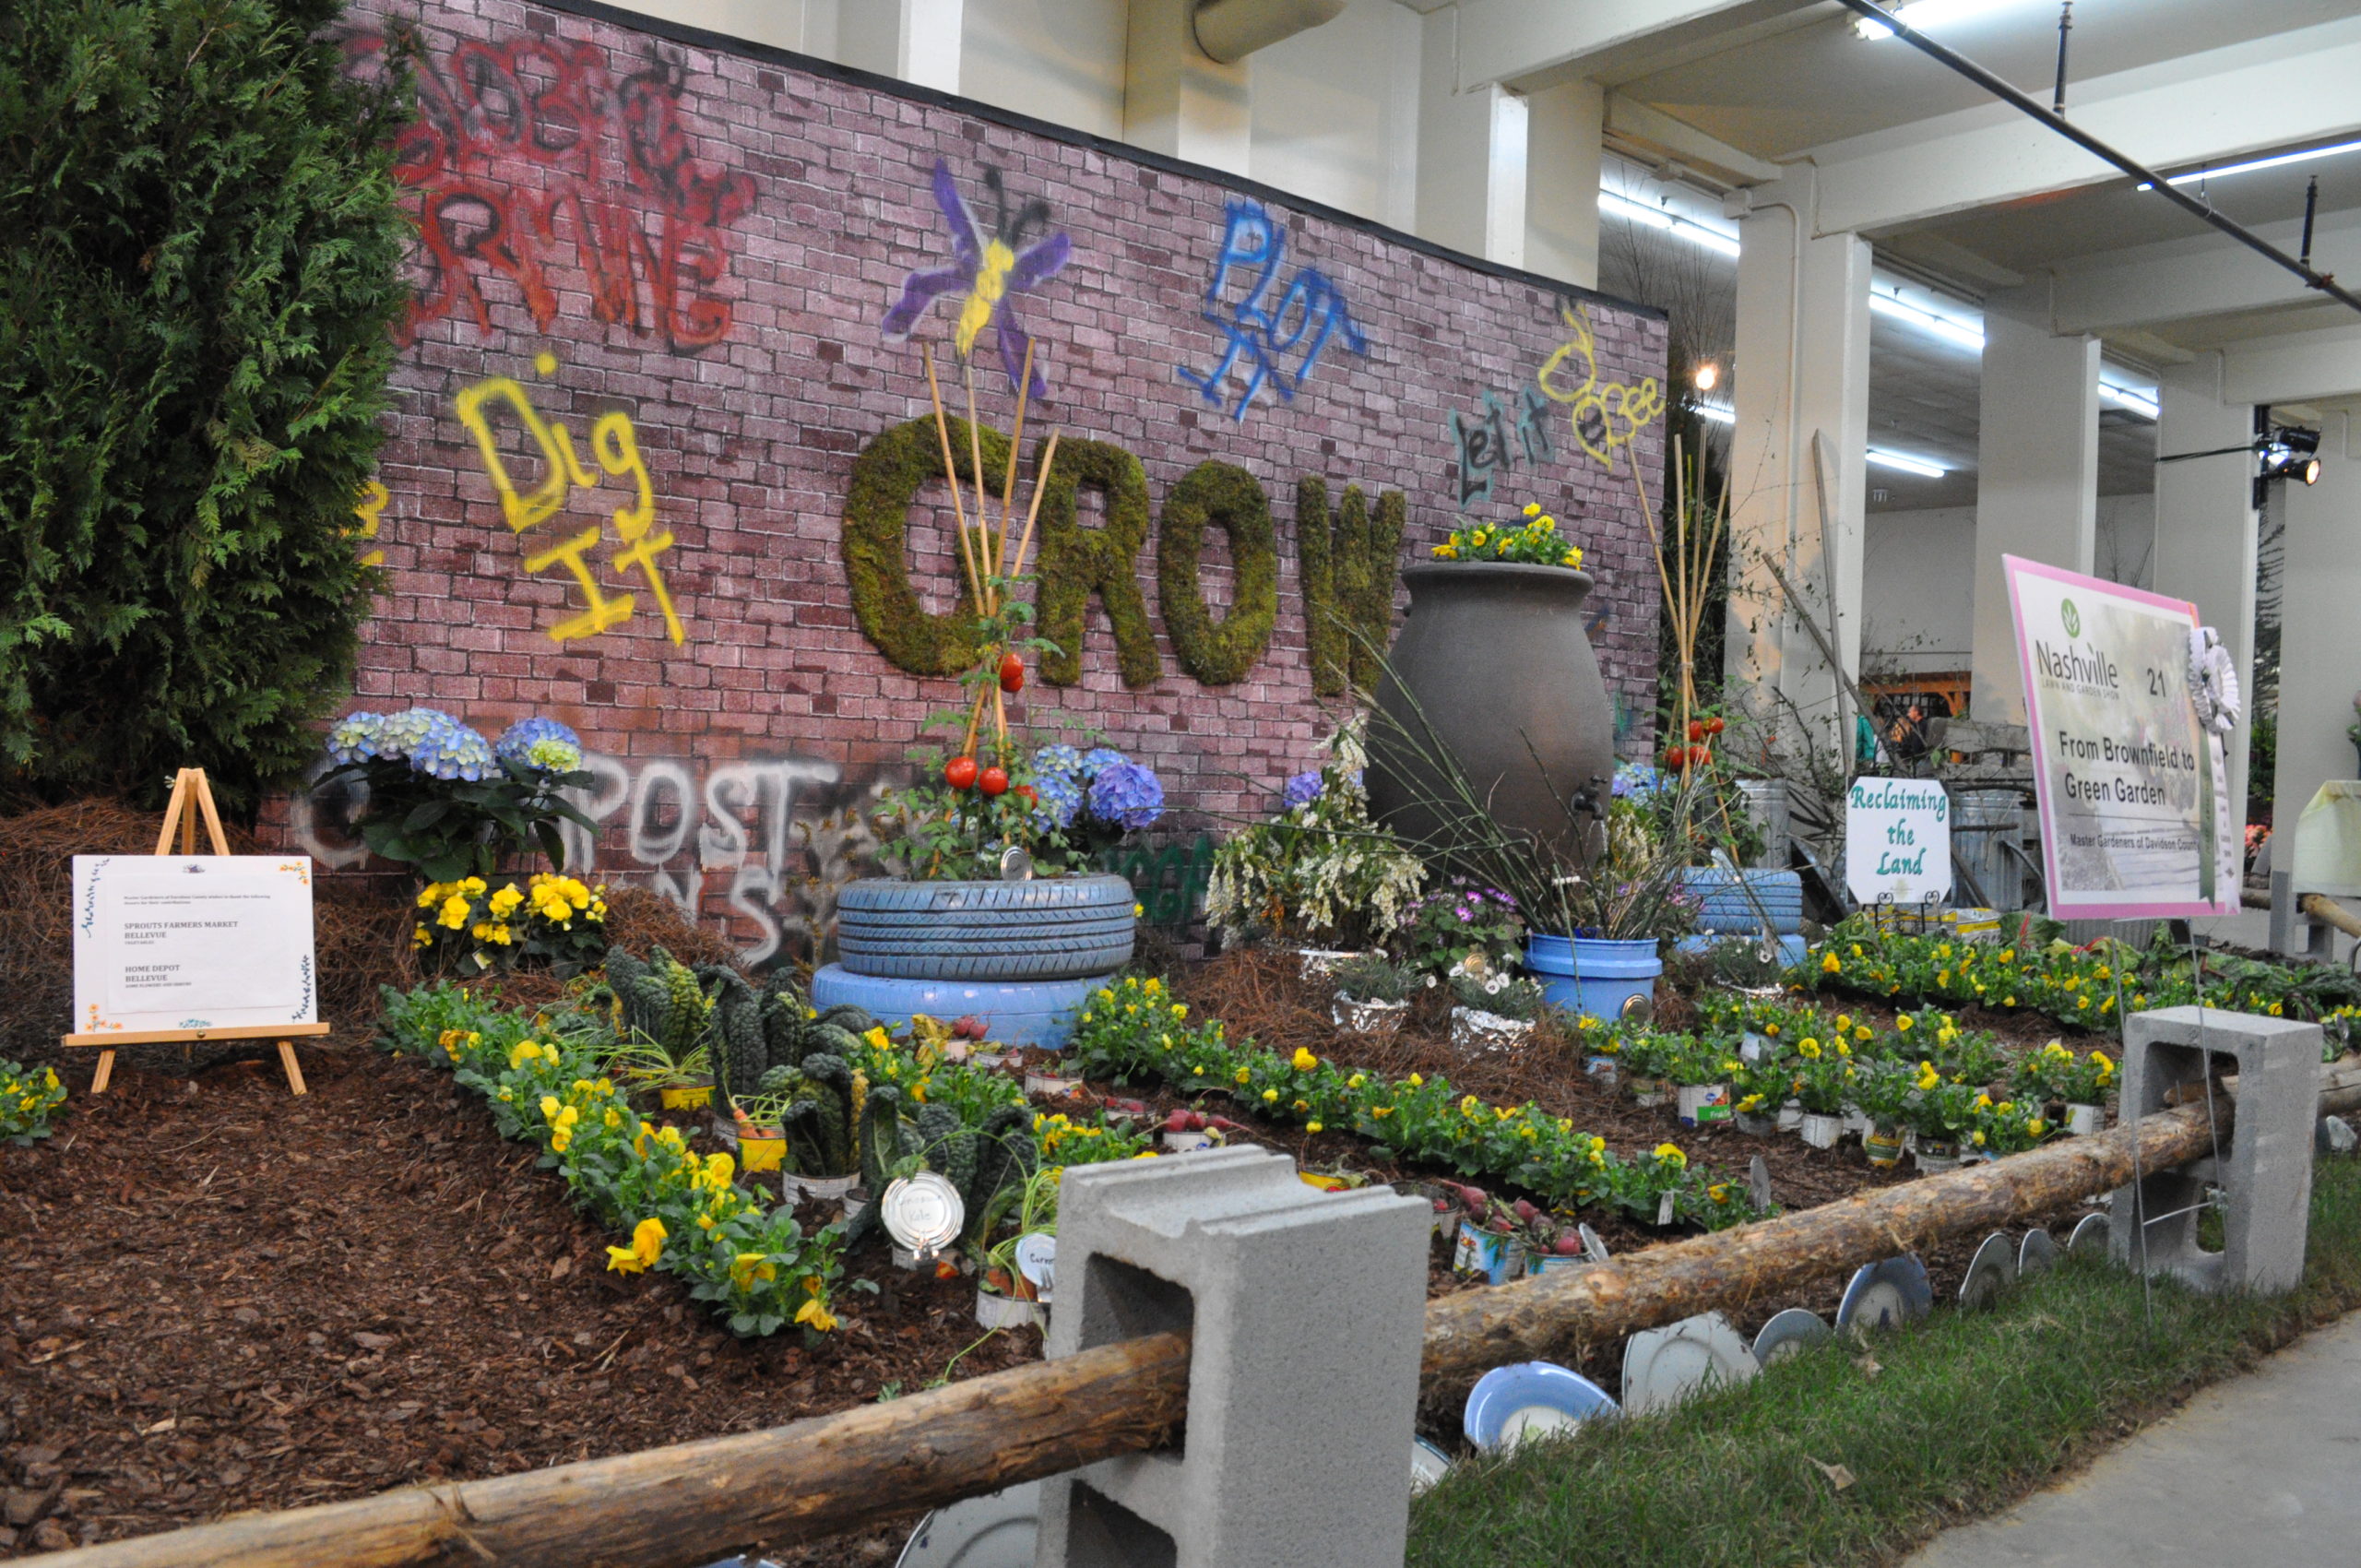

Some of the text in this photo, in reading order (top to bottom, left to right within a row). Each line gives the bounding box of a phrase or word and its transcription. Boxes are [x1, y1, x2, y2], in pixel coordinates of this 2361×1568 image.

[456, 353, 656, 544] Dig
[841, 412, 1406, 697] GROW
[2035, 639, 2118, 689] Nashville
[2062, 682, 2075, 694] AND
[2076, 684, 2102, 698] GARDEN
[2147, 667, 2166, 698] 21
[2058, 731, 2195, 771] From Brownfield to
[1850, 781, 1947, 822] Reclaiming
[2064, 772, 2166, 805] Green Garden
[1886, 817, 1915, 846] the
[2070, 833, 2095, 847] Master
[2096, 835, 2135, 849] Gardeners
[2136, 837, 2143, 849] of
[2144, 837, 2177, 850] Davidson
[1875, 847, 1927, 875] Land
[124, 921, 239, 931] SPROUTS FARMERS MARKET
[125, 932, 168, 940] BELLEVUE
[125, 964, 181, 974] HOME DEPOT
[125, 974, 168, 982] BELLEVUE
